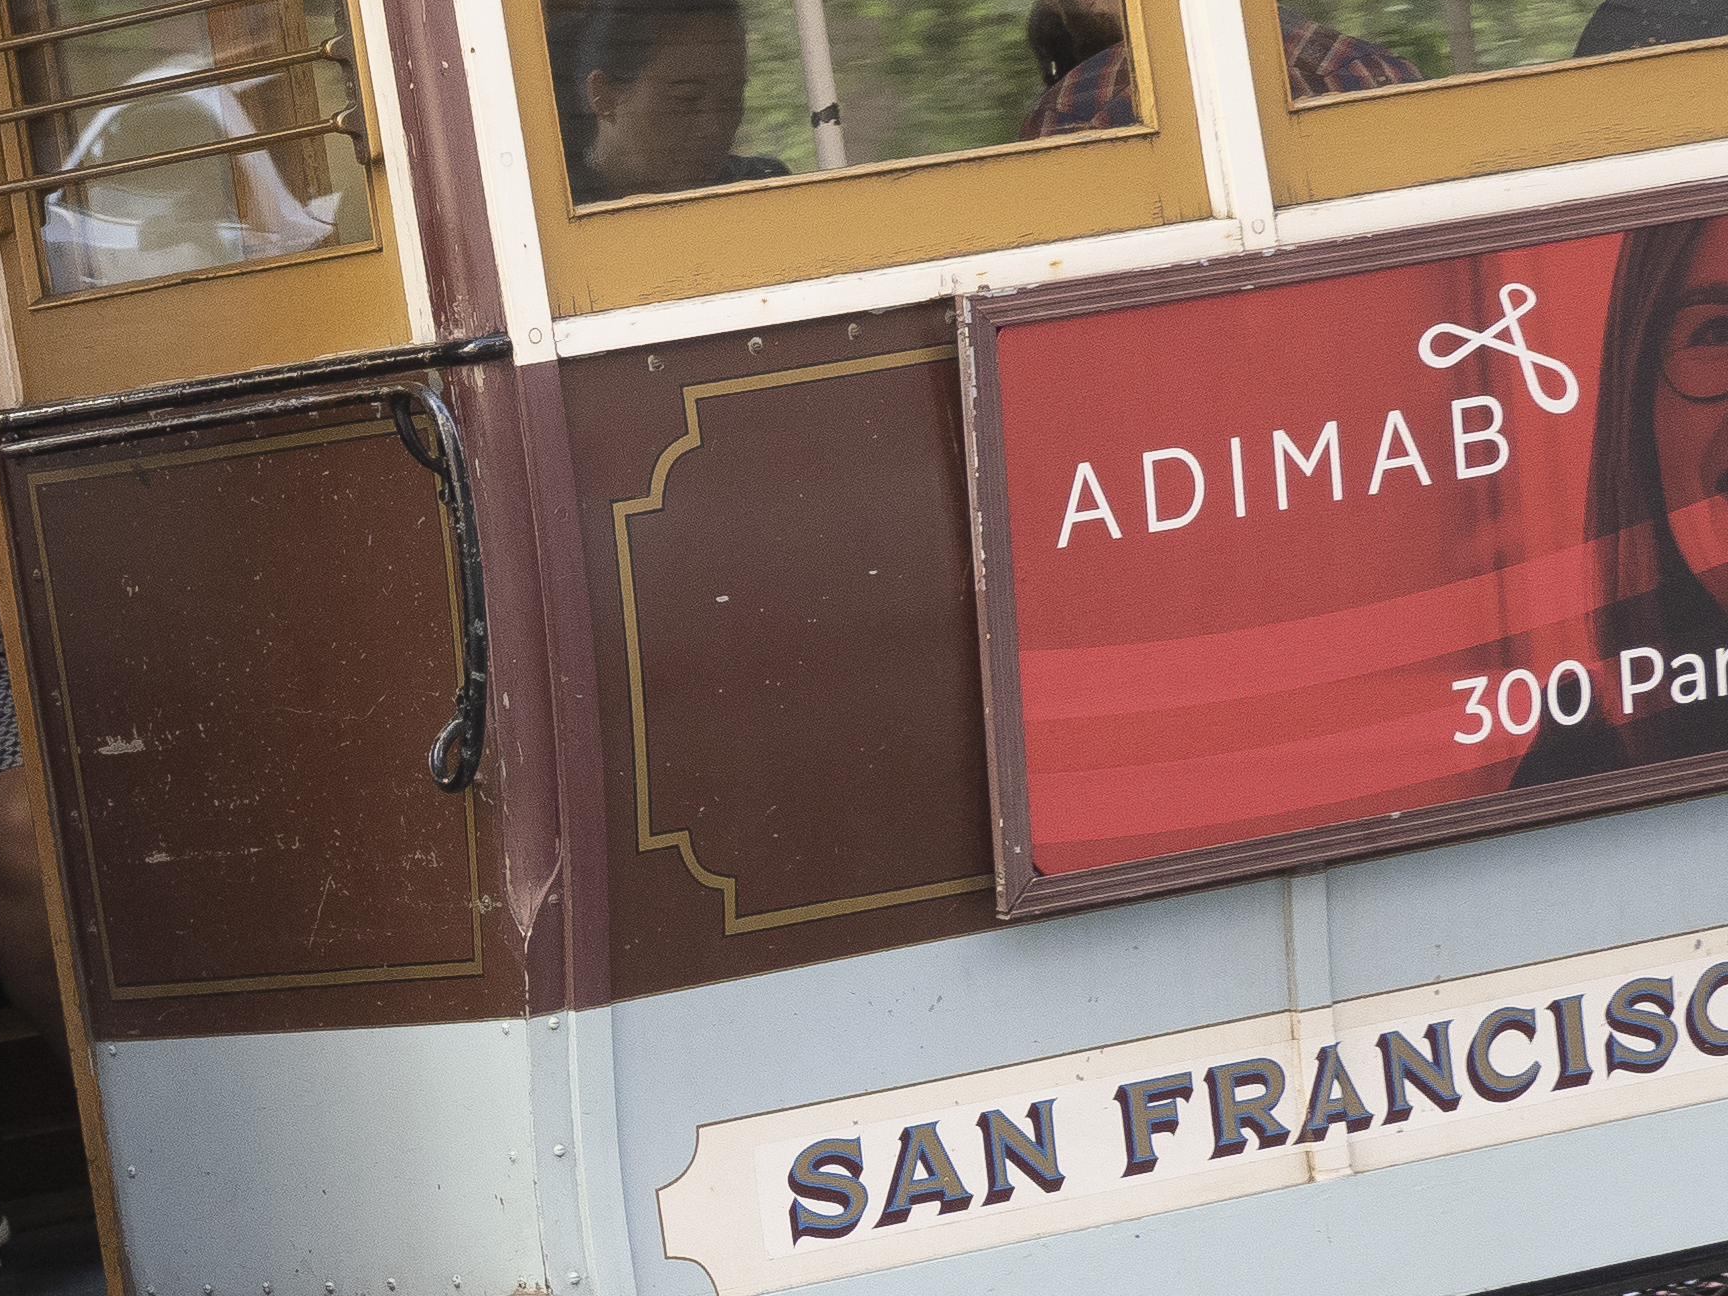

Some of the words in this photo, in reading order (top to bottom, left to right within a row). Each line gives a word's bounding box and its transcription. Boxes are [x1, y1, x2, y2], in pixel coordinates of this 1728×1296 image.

[1055, 394, 1511, 550] ADIMAB
[1450, 658, 1592, 746] 300
[787, 1095, 1065, 1248] SAN
